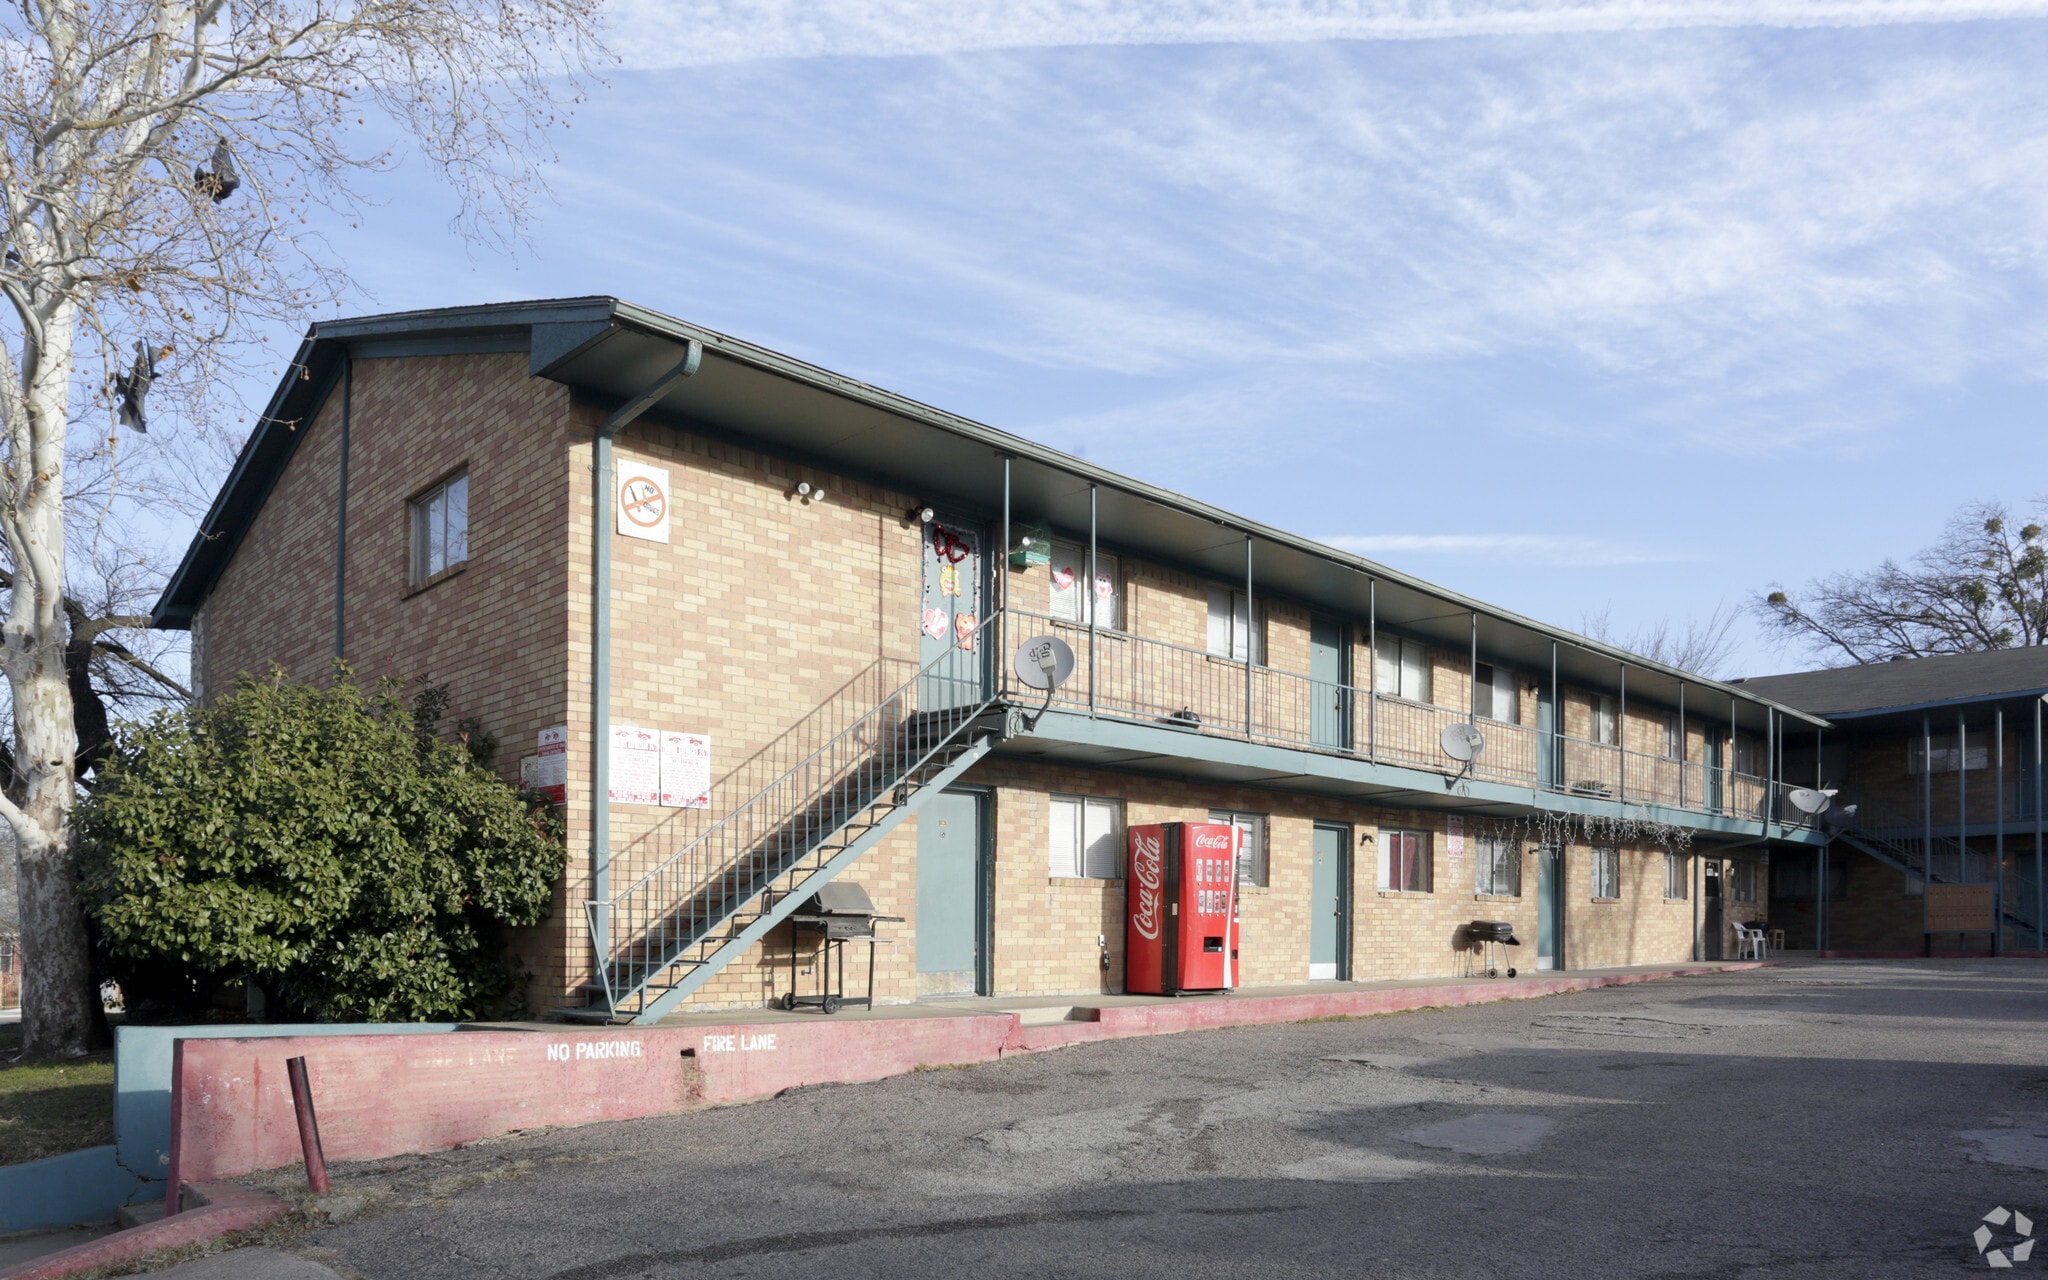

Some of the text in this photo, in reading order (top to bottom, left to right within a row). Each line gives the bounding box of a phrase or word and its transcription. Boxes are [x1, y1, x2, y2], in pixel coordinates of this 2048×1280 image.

[644, 484, 655, 495] NO
[1195, 833, 1230, 849] Coca-Cola
[1133, 832, 1160, 940] Coca-Cola
[547, 1041, 641, 1061] NO PARKING
[703, 1033, 777, 1052] FIRE LANE
